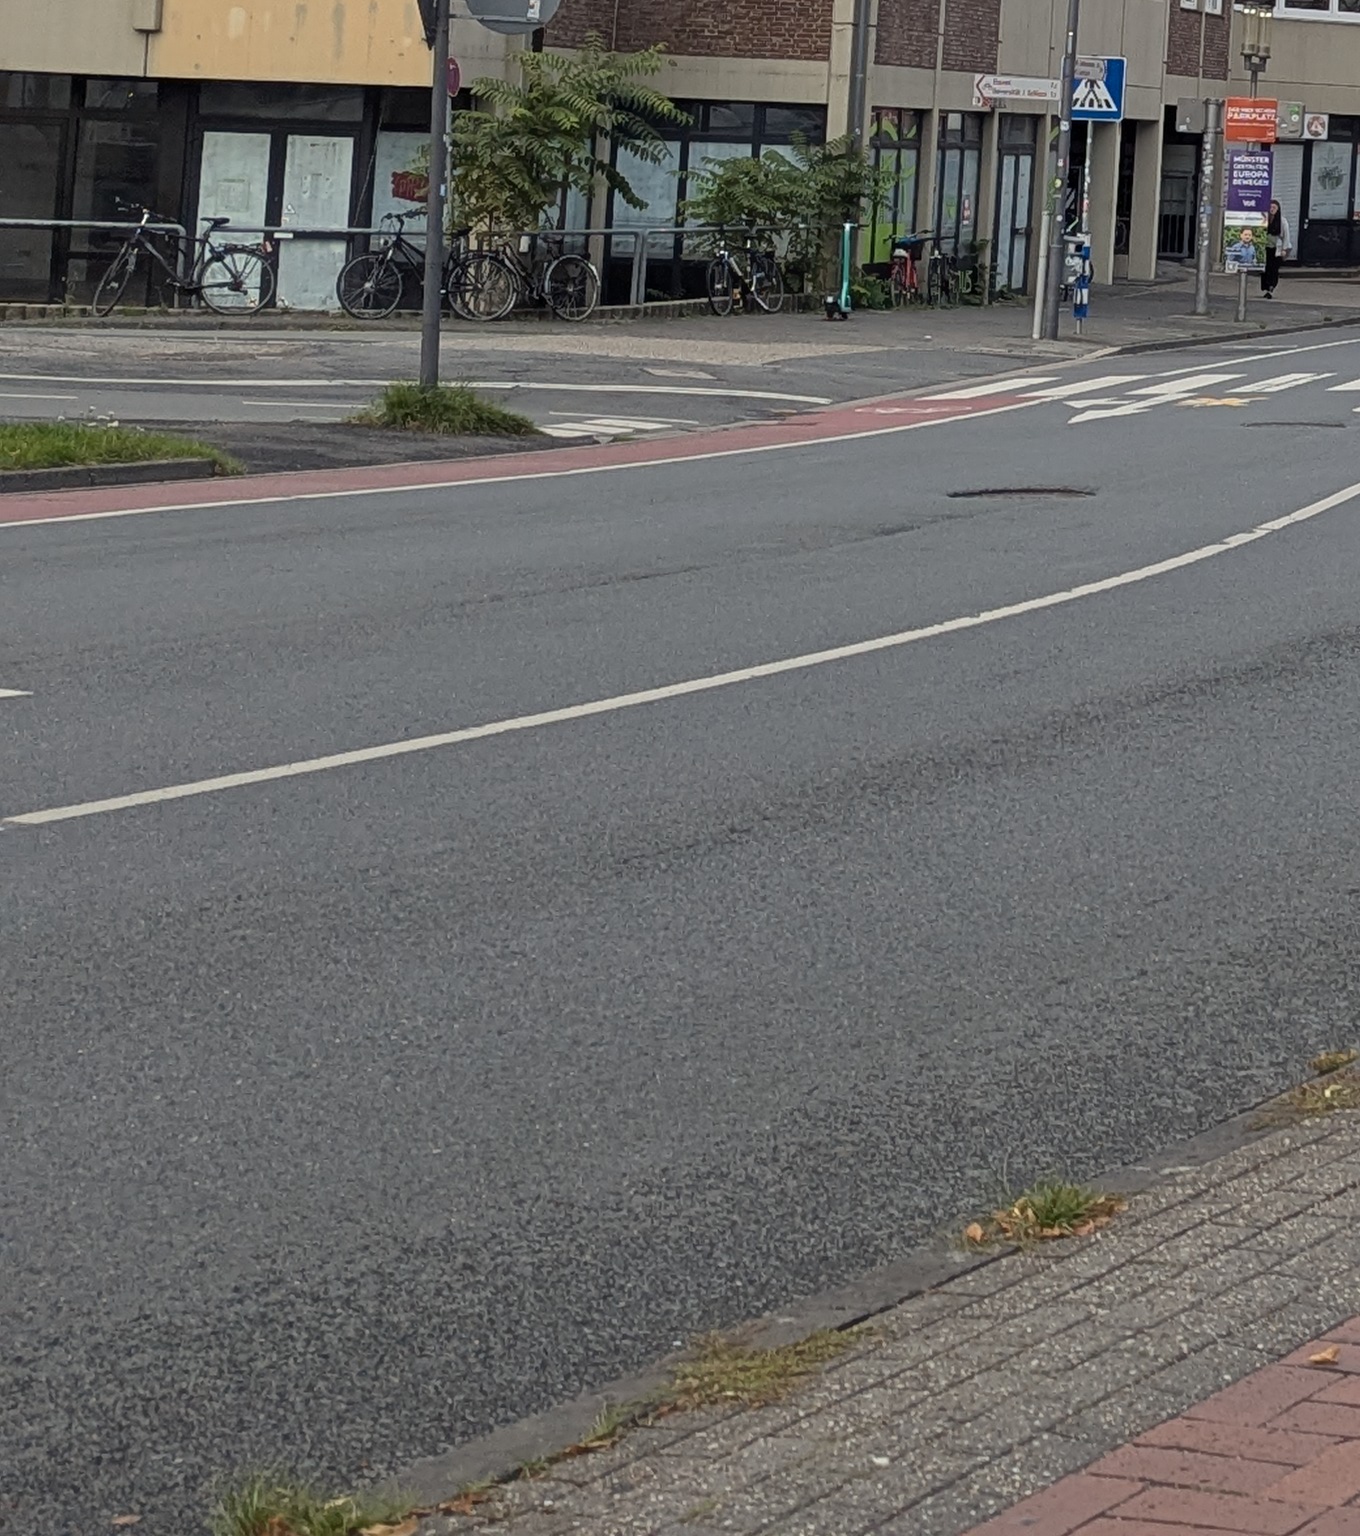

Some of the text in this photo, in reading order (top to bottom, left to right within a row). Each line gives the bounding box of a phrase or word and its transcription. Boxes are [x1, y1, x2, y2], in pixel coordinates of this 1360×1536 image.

[1233, 155, 1269, 163] MÜNSTER
[1233, 170, 1269, 178] EUROPA
[1232, 178, 1269, 186] BEWEGEN
